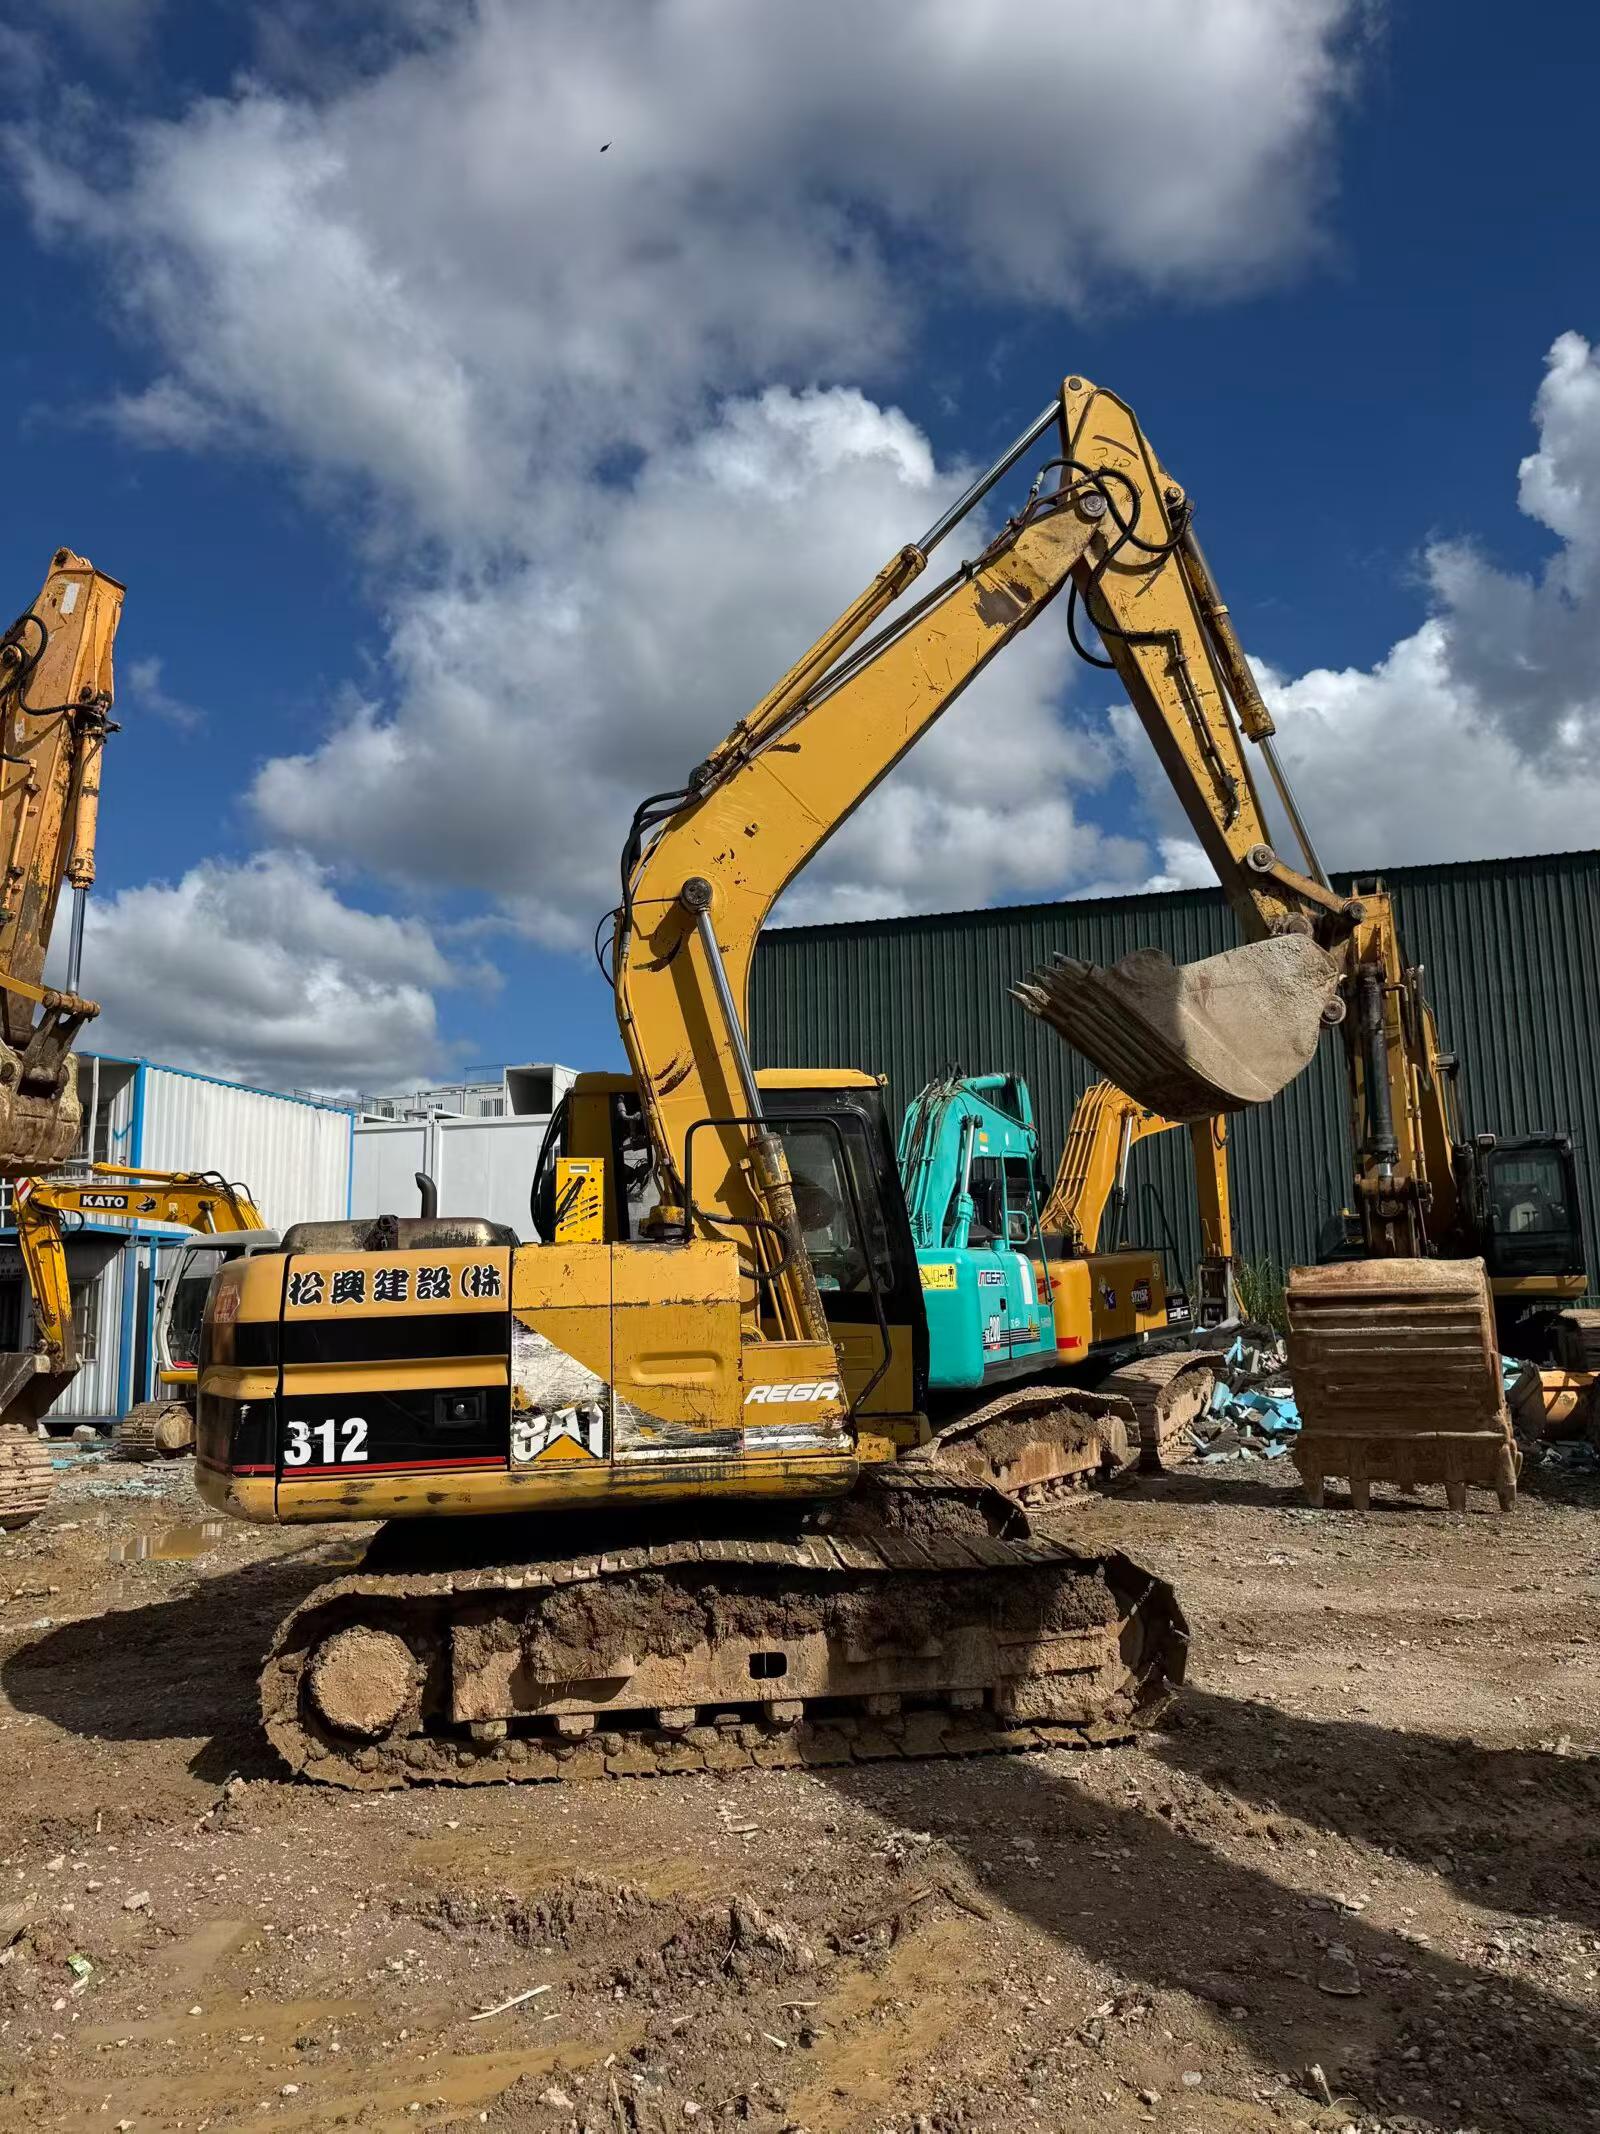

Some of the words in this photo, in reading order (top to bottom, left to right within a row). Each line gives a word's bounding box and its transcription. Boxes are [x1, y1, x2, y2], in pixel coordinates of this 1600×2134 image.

[82, 1195, 125, 1207] KATO
[743, 1381, 840, 1405] REGA
[284, 1417, 368, 1465] 312
